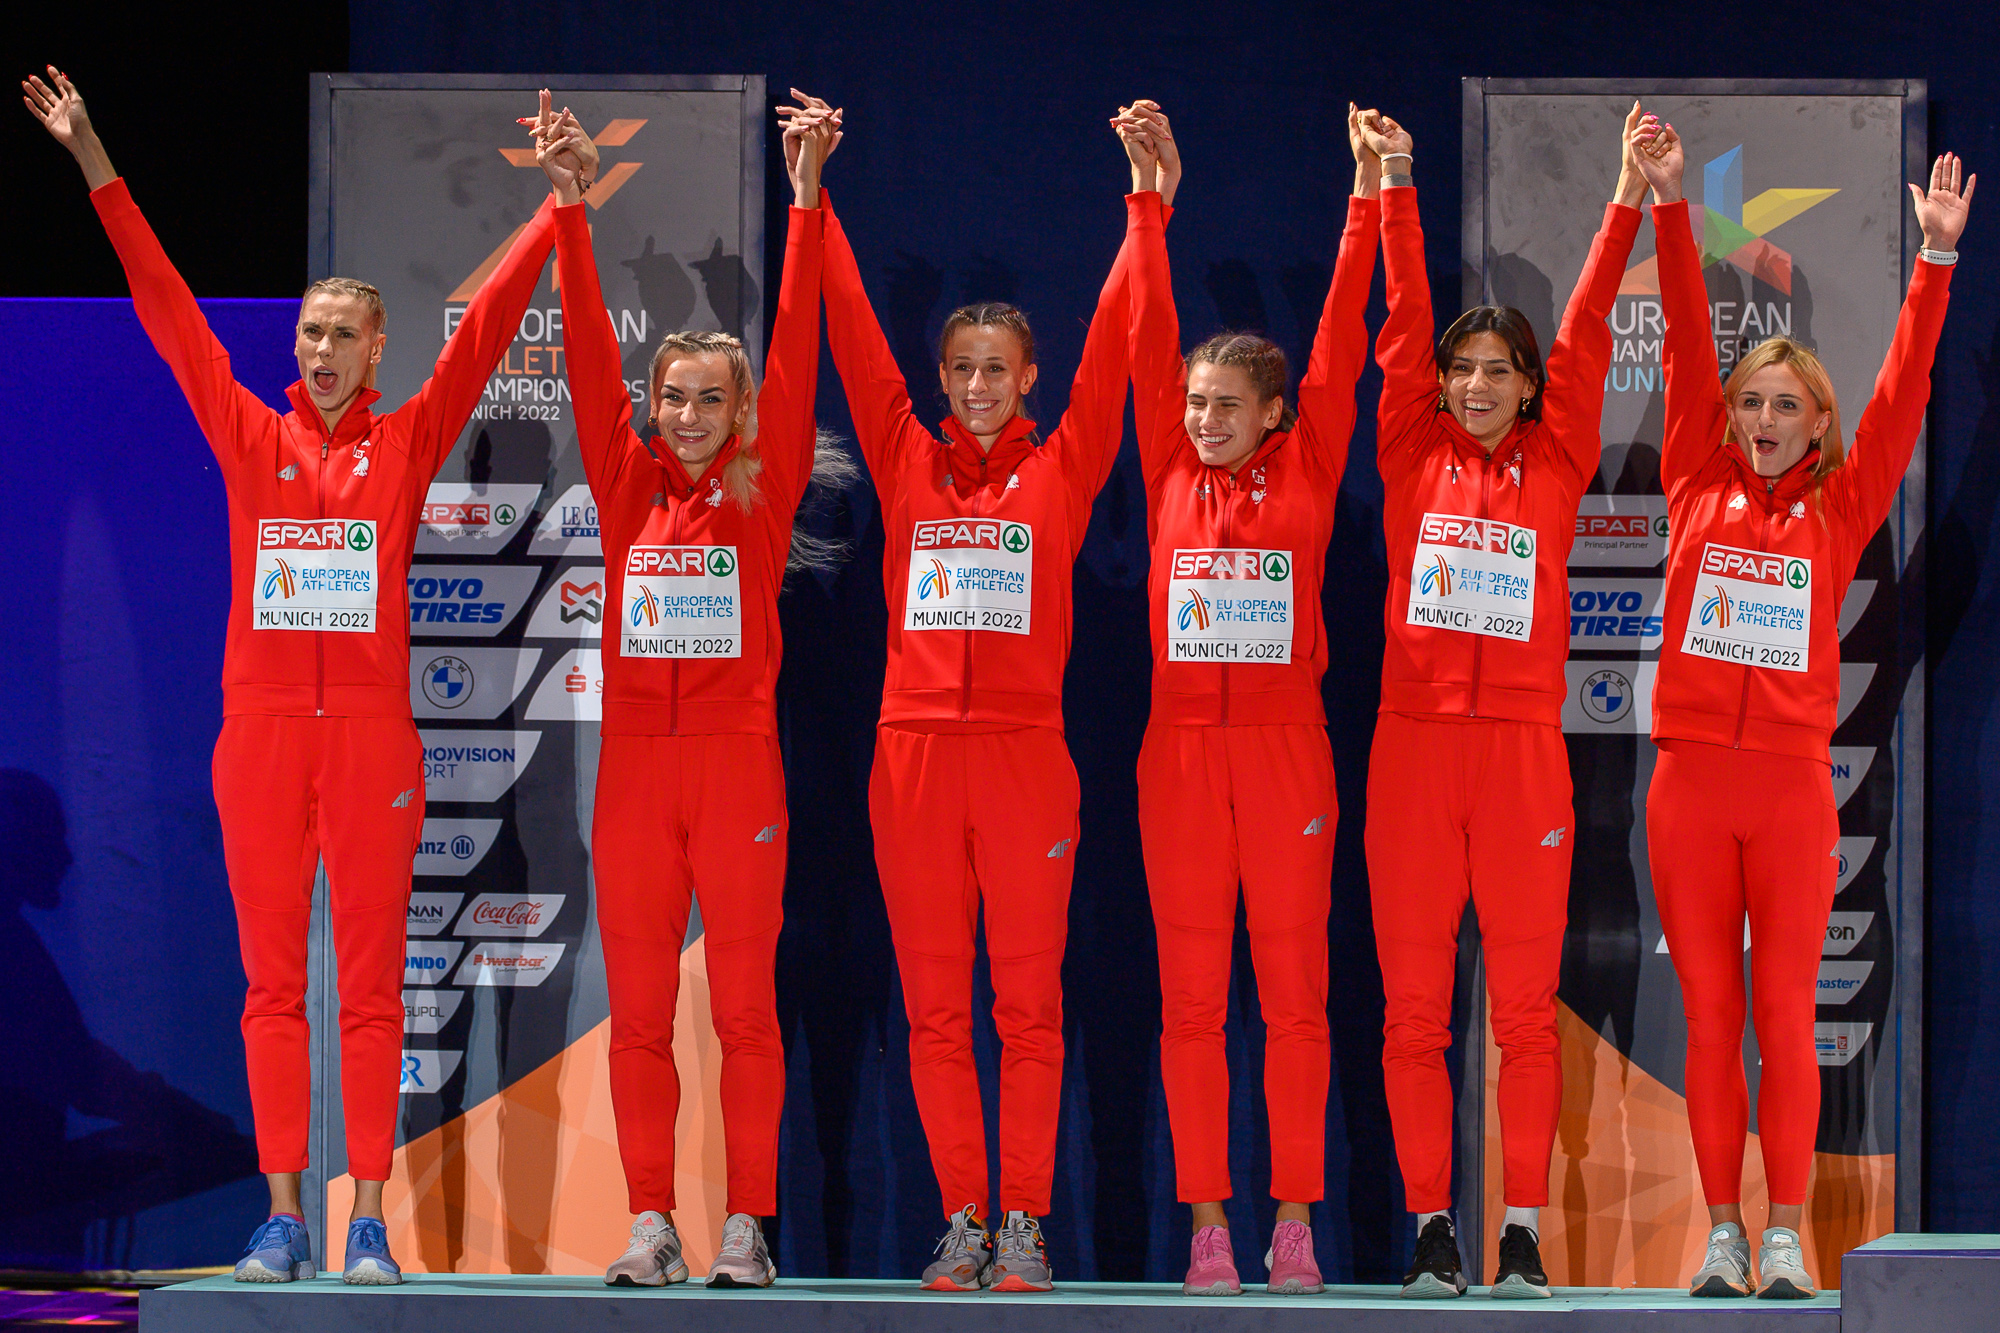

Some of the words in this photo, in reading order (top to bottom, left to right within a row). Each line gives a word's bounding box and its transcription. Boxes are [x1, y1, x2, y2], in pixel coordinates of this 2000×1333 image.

[471, 404, 512, 420] NICH
[518, 404, 561, 421] 2022
[562, 506, 581, 525] LE
[263, 525, 343, 546] SPAR
[427, 529, 460, 538] Principal
[462, 529, 489, 537] Partner
[917, 524, 998, 547] SPAR
[1423, 520, 1507, 550] SPAR
[1584, 541, 1618, 550] Principal
[1619, 541, 1649, 549] Partner
[629, 552, 703, 573] SPAR
[1176, 555, 1258, 576] SPAR
[1705, 550, 1782, 582] SPAR
[302, 568, 370, 581] EUROPEAN
[956, 567, 1025, 583] EUROPEAN
[1460, 568, 1529, 589] EUROPEAN
[301, 580, 371, 592] ATHLETICS
[955, 579, 1024, 594] ATHLETICS
[1458, 580, 1528, 600] ATHLETICS
[664, 595, 733, 607] EUROPEAN
[1216, 599, 1287, 611] EUROPEAN
[1570, 591, 1643, 612] OYO
[1738, 600, 1804, 619] EUROPEAN
[260, 611, 323, 626] MUNICH
[329, 612, 369, 628] 2022
[409, 602, 505, 623] TIRES
[664, 607, 733, 618] ATHLETICS
[913, 611, 976, 626] MUNICH
[982, 611, 1023, 629] 2022
[1215, 611, 1287, 623] ATHLETICS
[1736, 612, 1803, 631] ATHLETICS
[1483, 616, 1524, 636] 2022
[1570, 616, 1663, 637] TIRES
[628, 638, 686, 654] MUNICH
[692, 638, 733, 654] 2022
[1175, 642, 1238, 658] MUNICH
[1245, 643, 1284, 659] 2022
[1690, 636, 1754, 661] MUNICH
[1760, 648, 1800, 667] 2022
[430, 658, 467, 673] BMW
[1588, 673, 1626, 687] BMW
[392, 788, 415, 808] 4F
[754, 824, 779, 843] 4F
[1303, 814, 1328, 835] 4F
[1541, 827, 1566, 847] 4F
[1047, 838, 1072, 859] 4F
[473, 900, 546, 926] Coca-Cola
[473, 954, 545, 966] Powerbar
